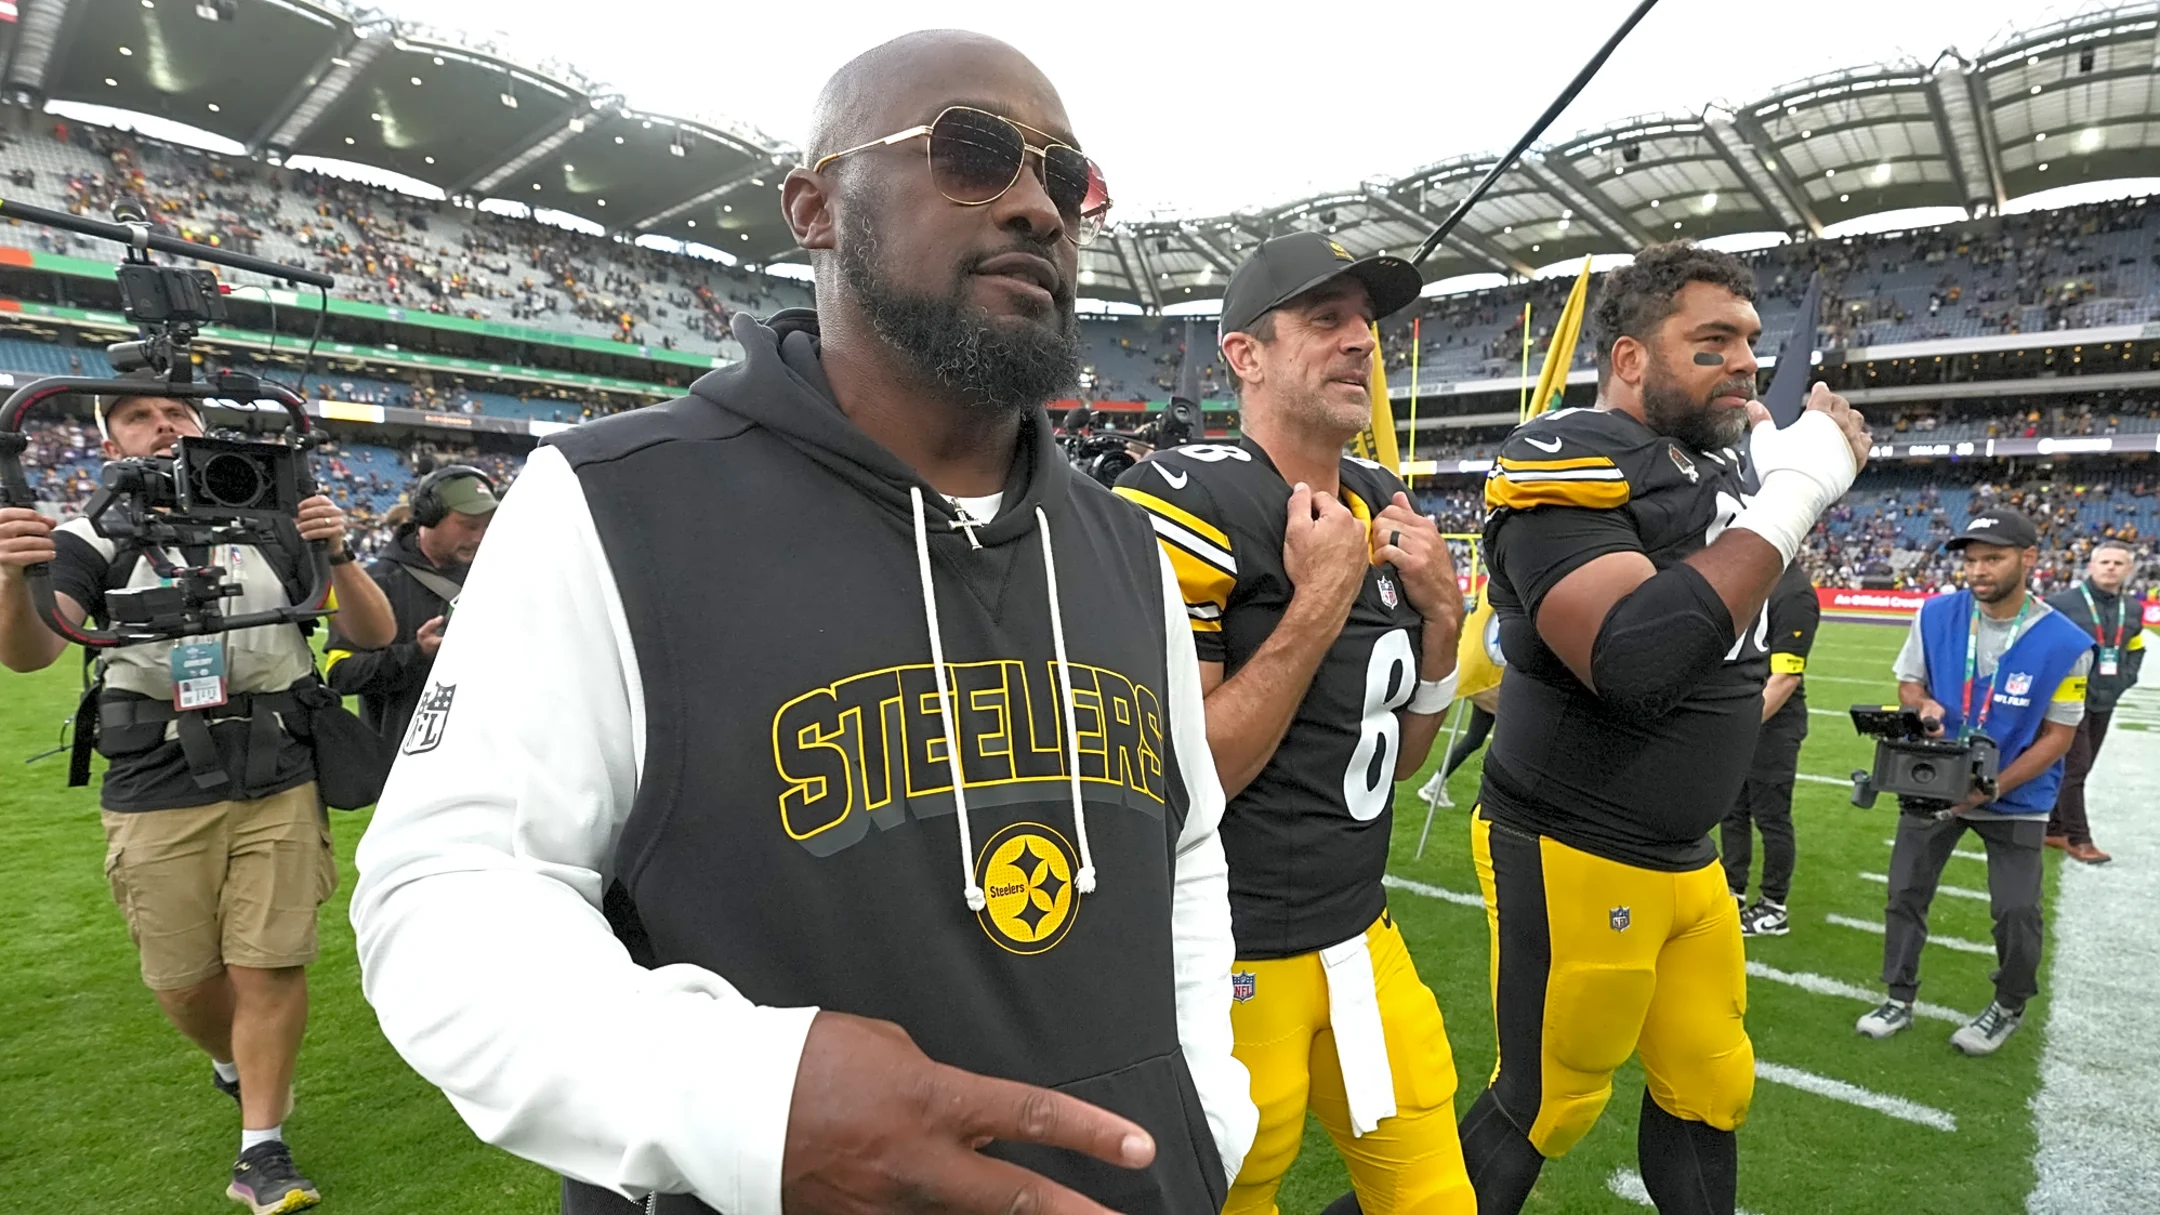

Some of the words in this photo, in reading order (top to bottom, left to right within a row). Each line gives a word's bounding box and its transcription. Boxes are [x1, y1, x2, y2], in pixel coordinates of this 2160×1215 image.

[1178, 444, 1252, 462] 8
[1344, 628, 1416, 821] 8
[773, 660, 1165, 841] STEELERS
[990, 882, 1025, 898] Steelers
[1234, 985, 1251, 998] NFL
